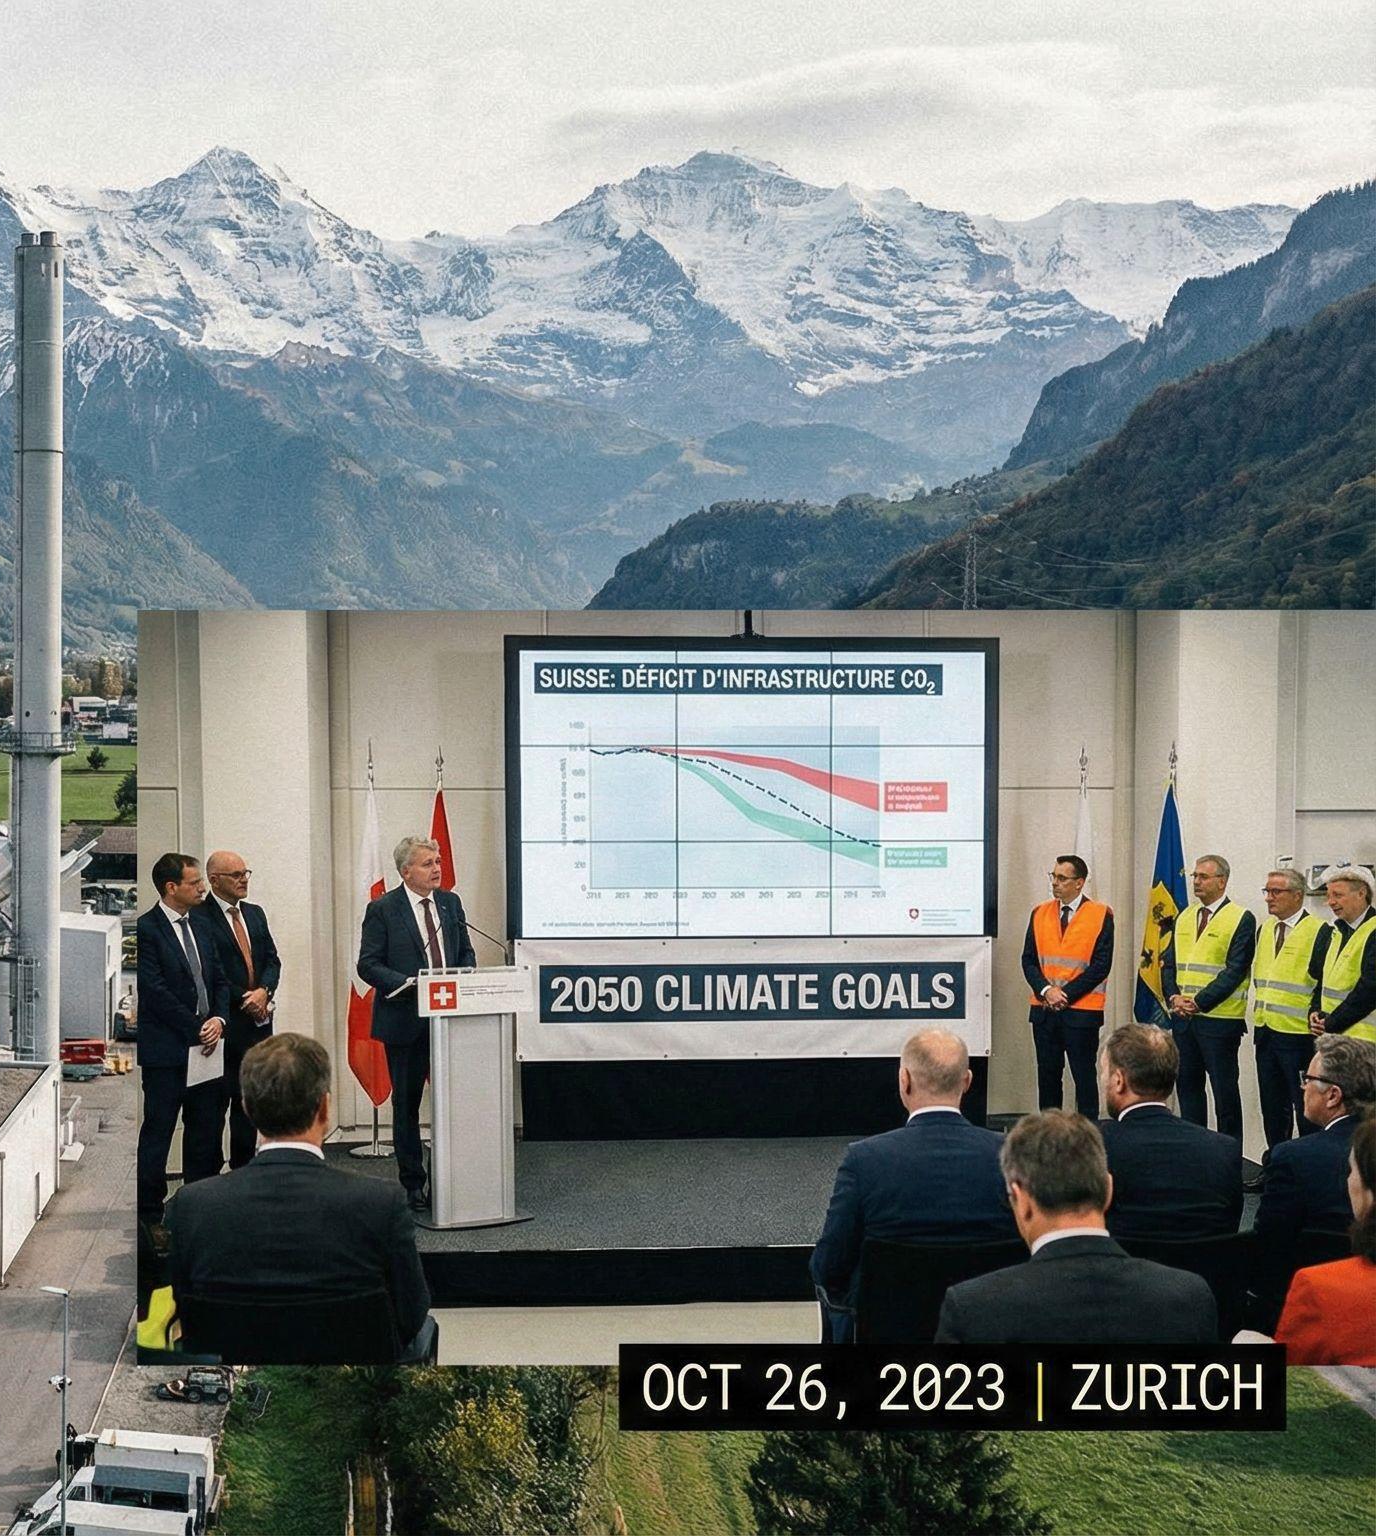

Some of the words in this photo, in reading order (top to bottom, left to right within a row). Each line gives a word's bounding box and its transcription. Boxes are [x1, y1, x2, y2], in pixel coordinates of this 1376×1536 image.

[539, 668, 616, 689] SUISSE:
[622, 664, 696, 689] DÉFICIT
[702, 668, 896, 690] D'INFRASTRUCTURE
[550, 976, 643, 1013] 2050
[655, 973, 819, 1012] CLIMATE
[832, 972, 955, 1010] GOALS
